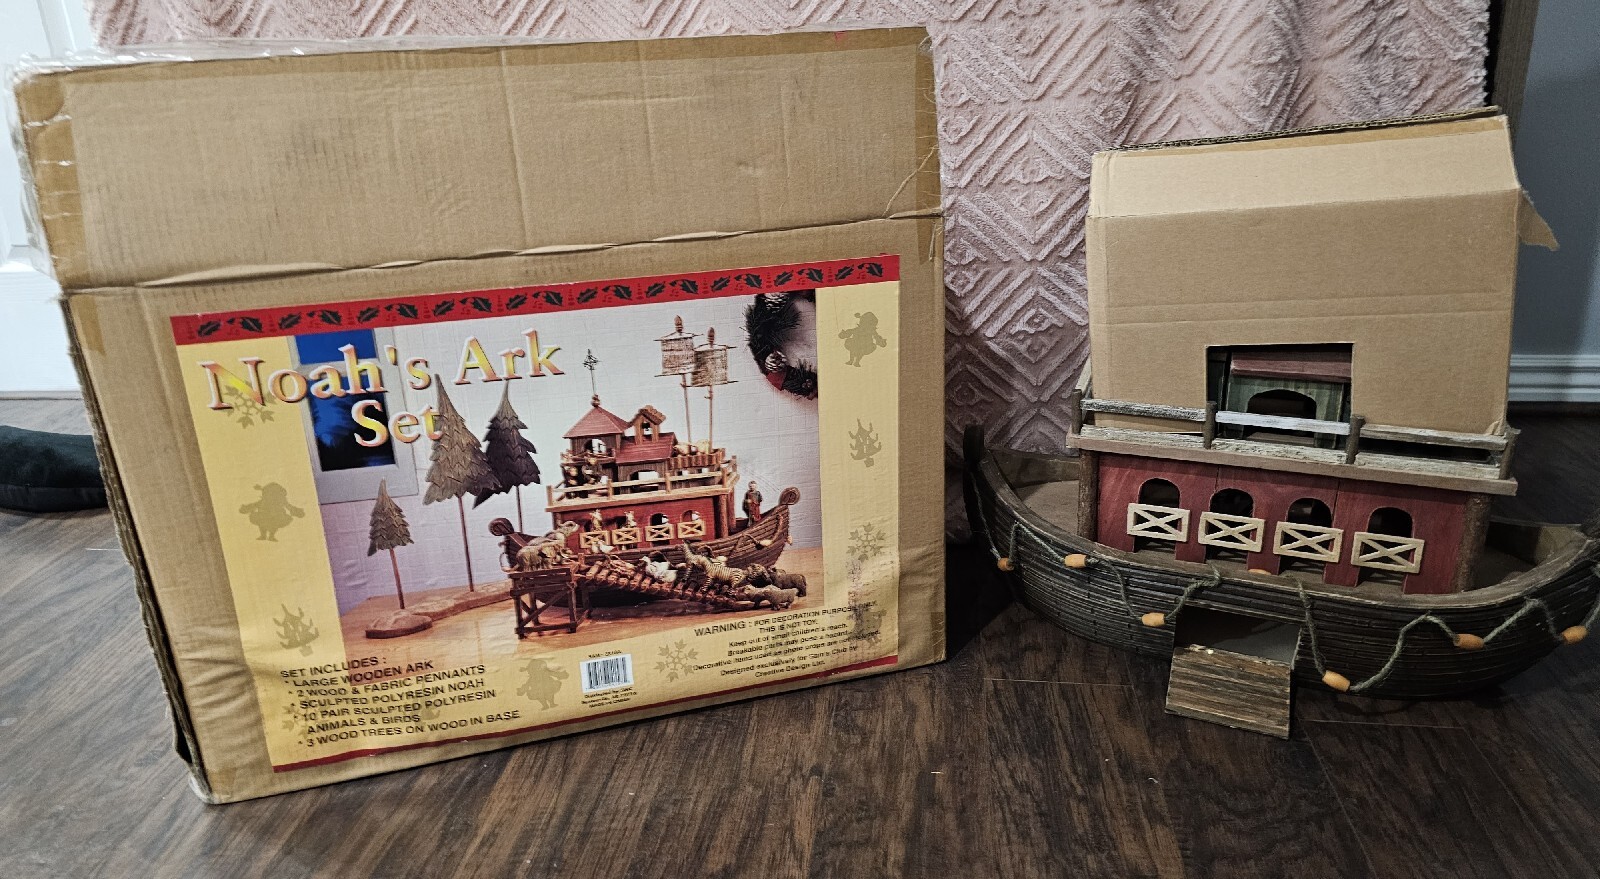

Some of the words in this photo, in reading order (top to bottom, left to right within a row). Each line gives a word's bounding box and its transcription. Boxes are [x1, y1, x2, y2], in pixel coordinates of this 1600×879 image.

[197, 343, 432, 410] Noah's
[452, 327, 566, 385] Ark
[351, 400, 443, 447] Set
[694, 620, 746, 636] WARNING
[754, 618, 770, 626] FOR
[772, 611, 820, 623] DECORATION
[759, 625, 776, 633] THIS
[786, 621, 801, 629] NOT
[727, 646, 763, 657] Breakable
[729, 640, 747, 648] Keep
[280, 668, 306, 678] SET
[309, 656, 379, 676] INCLUDES
[293, 677, 339, 687] LARGE
[340, 665, 402, 683] WOODEN
[406, 659, 434, 673] ARK
[693, 659, 732, 671] Decorative
[720, 665, 755, 676] Designed
[755, 667, 785, 678] Creative
[297, 689, 304, 697] 2
[307, 687, 347, 697] WOOD
[351, 687, 361, 695] &
[364, 678, 413, 693] FABRIC
[416, 664, 486, 684] PENNANTS
[300, 697, 368, 709] SCULPTED
[371, 685, 445, 704] POLYRESIN
[448, 678, 485, 692] NOAH
[303, 712, 317, 721] 10
[320, 708, 350, 718] PAIR
[353, 702, 422, 715] SCULPTED
[425, 689, 497, 709] POLYRESIN
[306, 738, 314, 747] 3
[316, 730, 358, 744] WOOD
[361, 727, 402, 736] TREES
[406, 725, 425, 734] ON
[428, 719, 468, 732] WOOD
[470, 716, 483, 725] IN
[486, 710, 520, 722] BASE
[307, 717, 366, 734] ANIMALS
[370, 717, 378, 725] &
[381, 714, 421, 724] BIRDS
